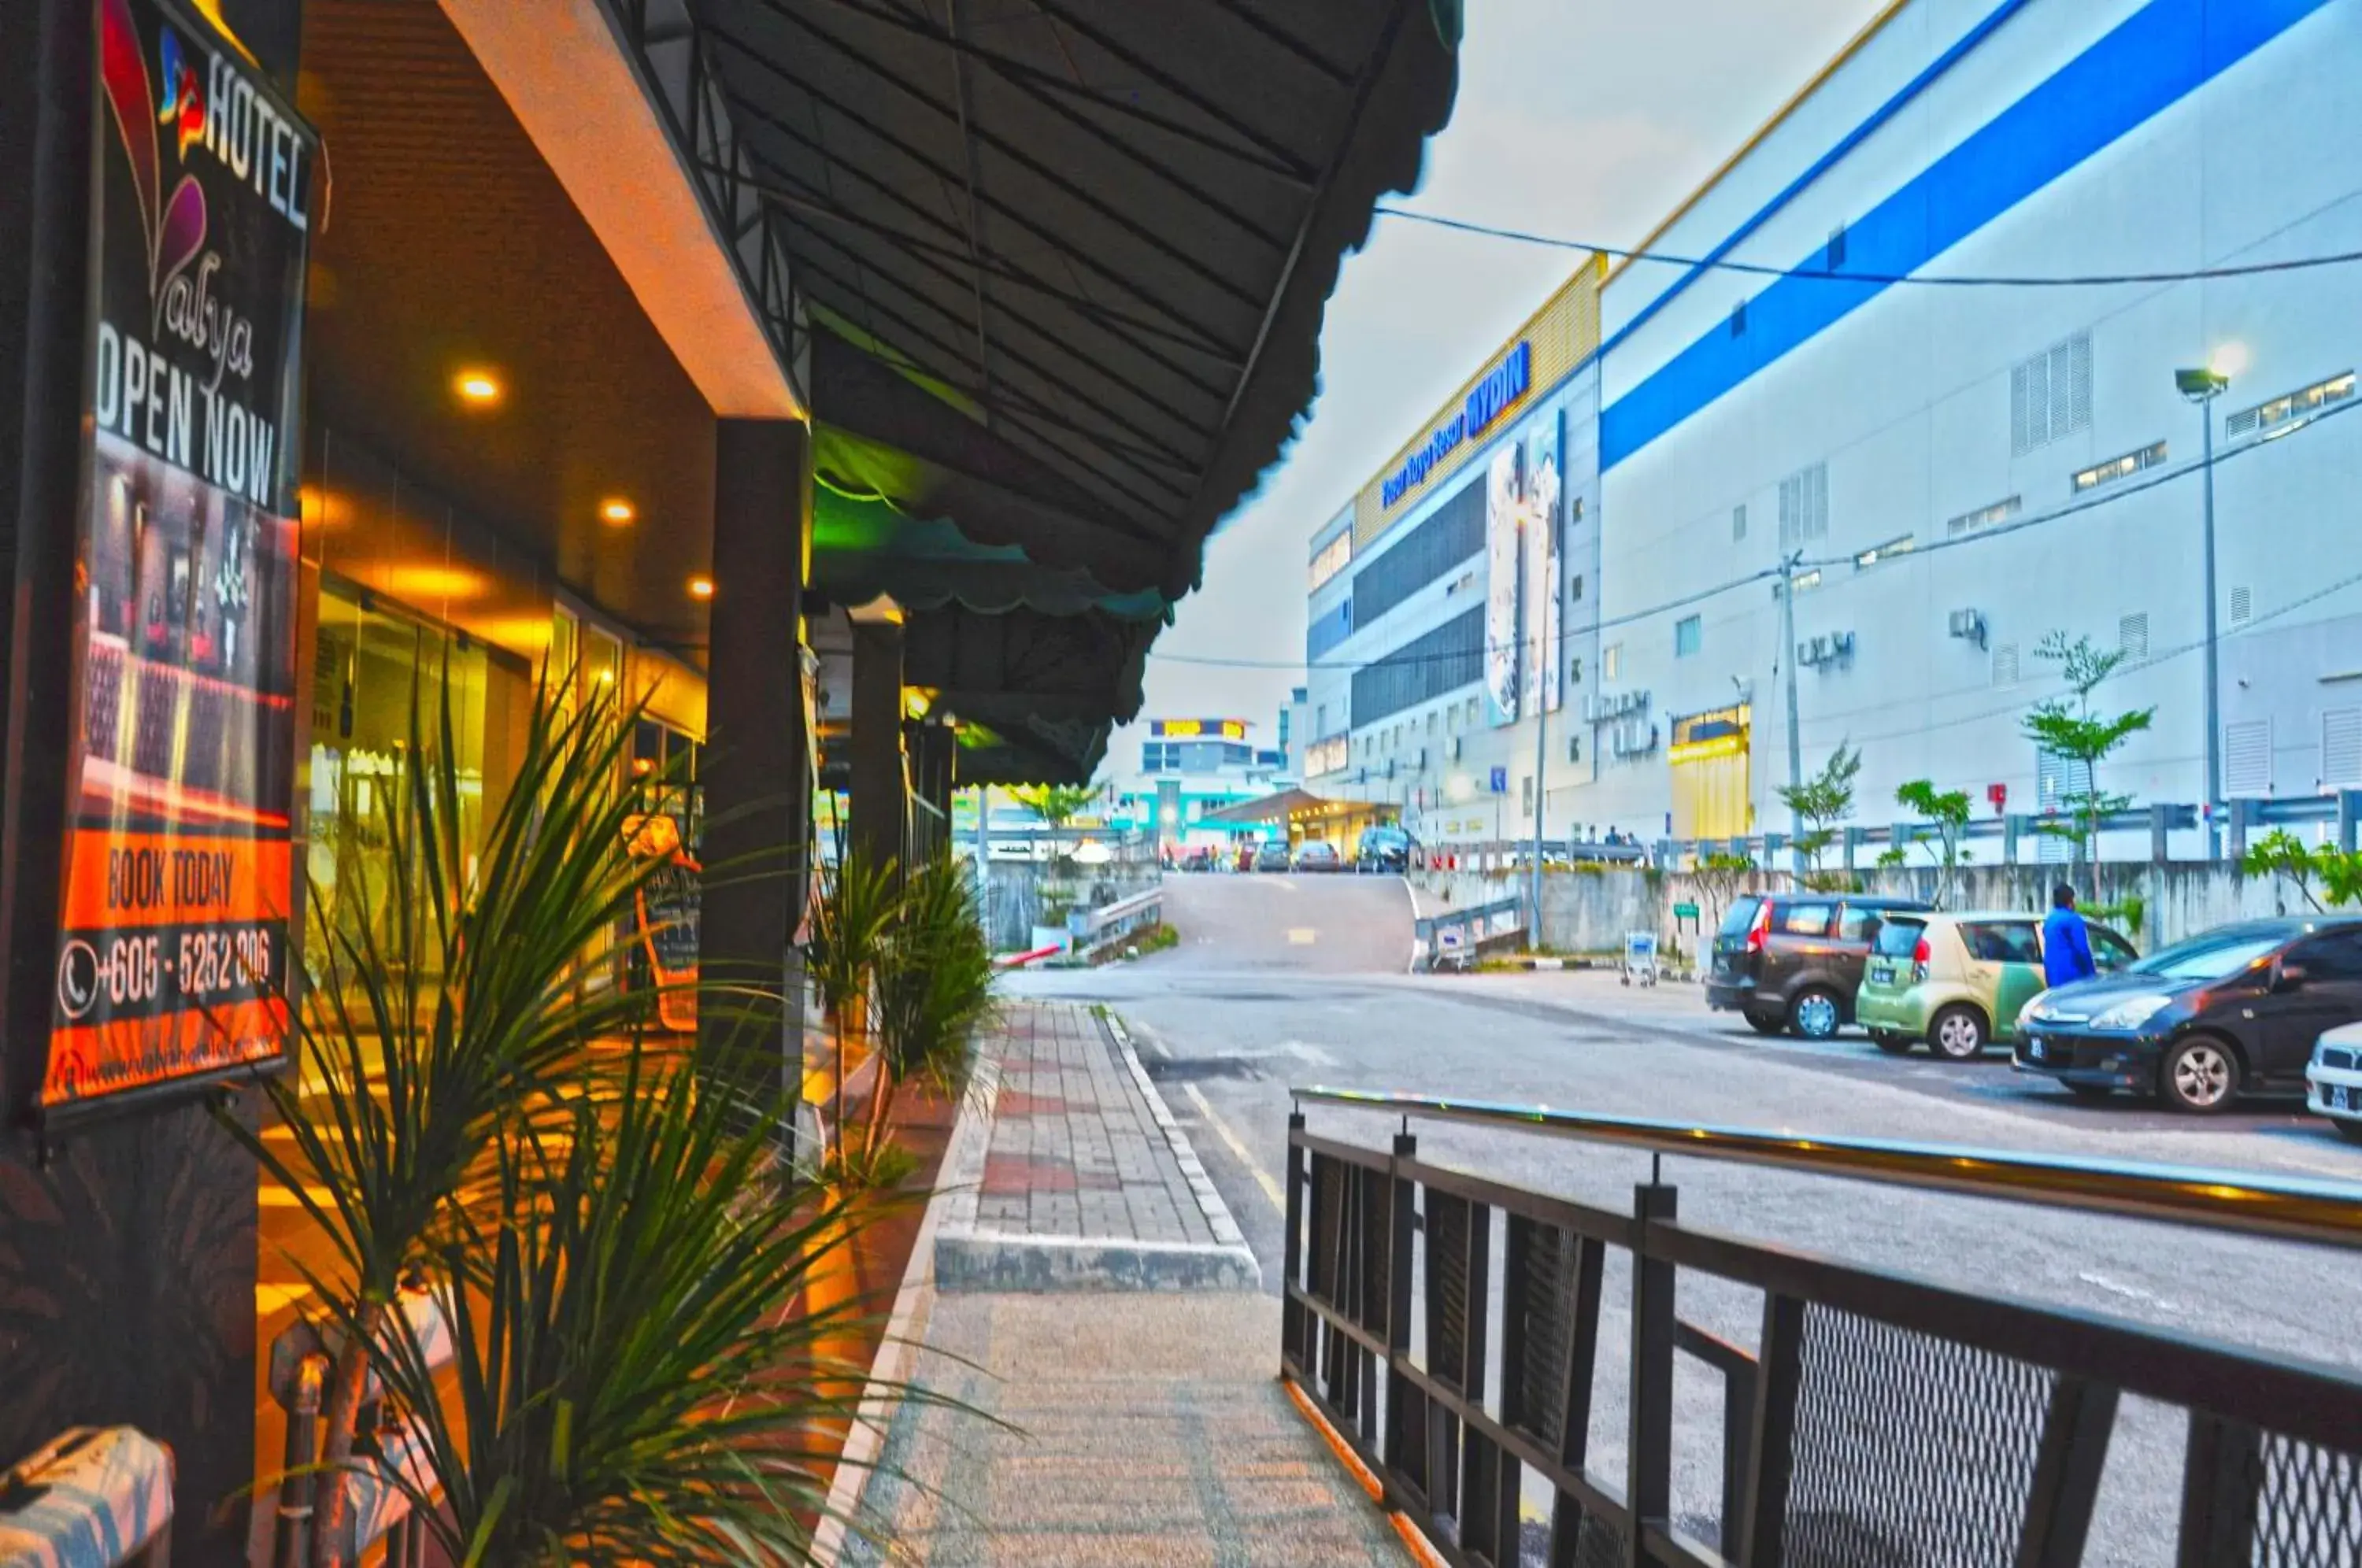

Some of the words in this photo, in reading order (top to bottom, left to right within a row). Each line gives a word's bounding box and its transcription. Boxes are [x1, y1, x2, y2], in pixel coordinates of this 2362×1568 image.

[206, 49, 307, 231] HOTEL
[97, 320, 191, 468] OPEN
[203, 390, 273, 508] NOW
[1465, 340, 1531, 438] MYDIN
[108, 847, 166, 911] BOOK
[173, 849, 233, 910] TODAY
[98, 934, 157, 1005] +605
[179, 929, 231, 994] 5252
